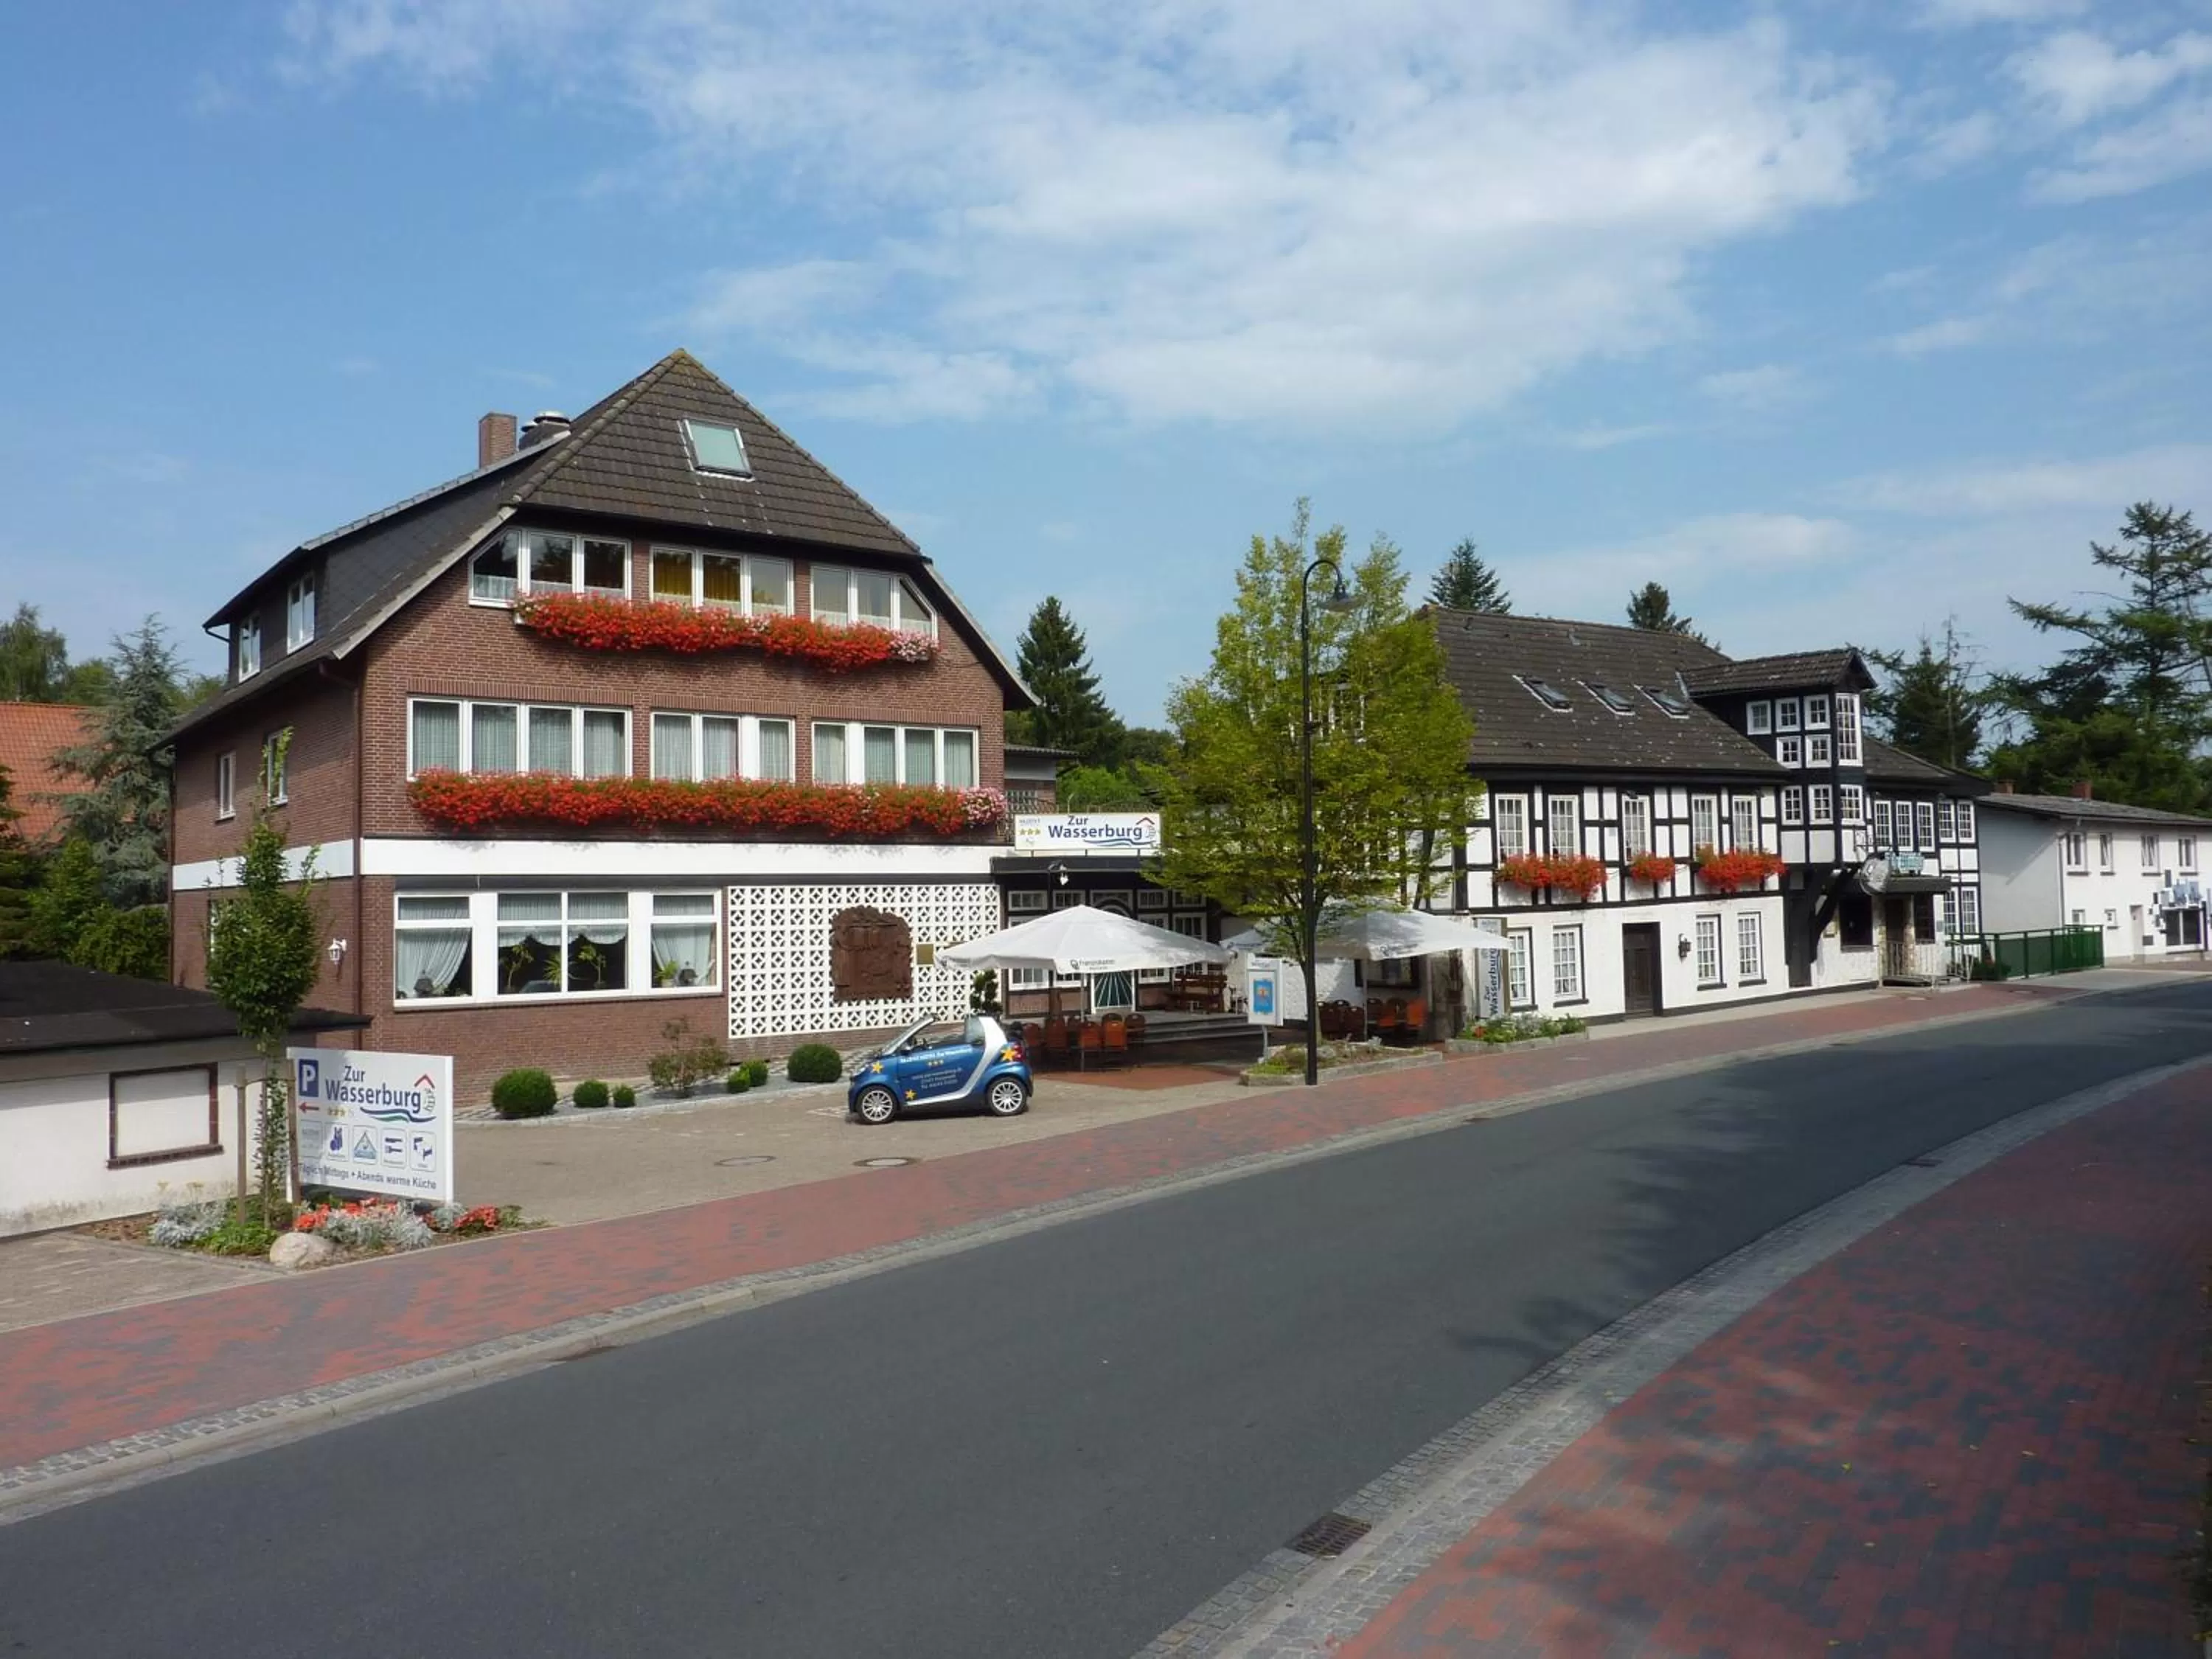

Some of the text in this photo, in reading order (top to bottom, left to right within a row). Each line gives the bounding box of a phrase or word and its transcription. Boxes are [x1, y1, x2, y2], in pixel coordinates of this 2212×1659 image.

[1068, 815, 1088, 825] Zur
[1048, 824, 1142, 841] Wasserburg
[302, 1064, 316, 1092] P
[344, 1065, 366, 1082] Zur
[325, 1078, 421, 1113] Wasserburg
